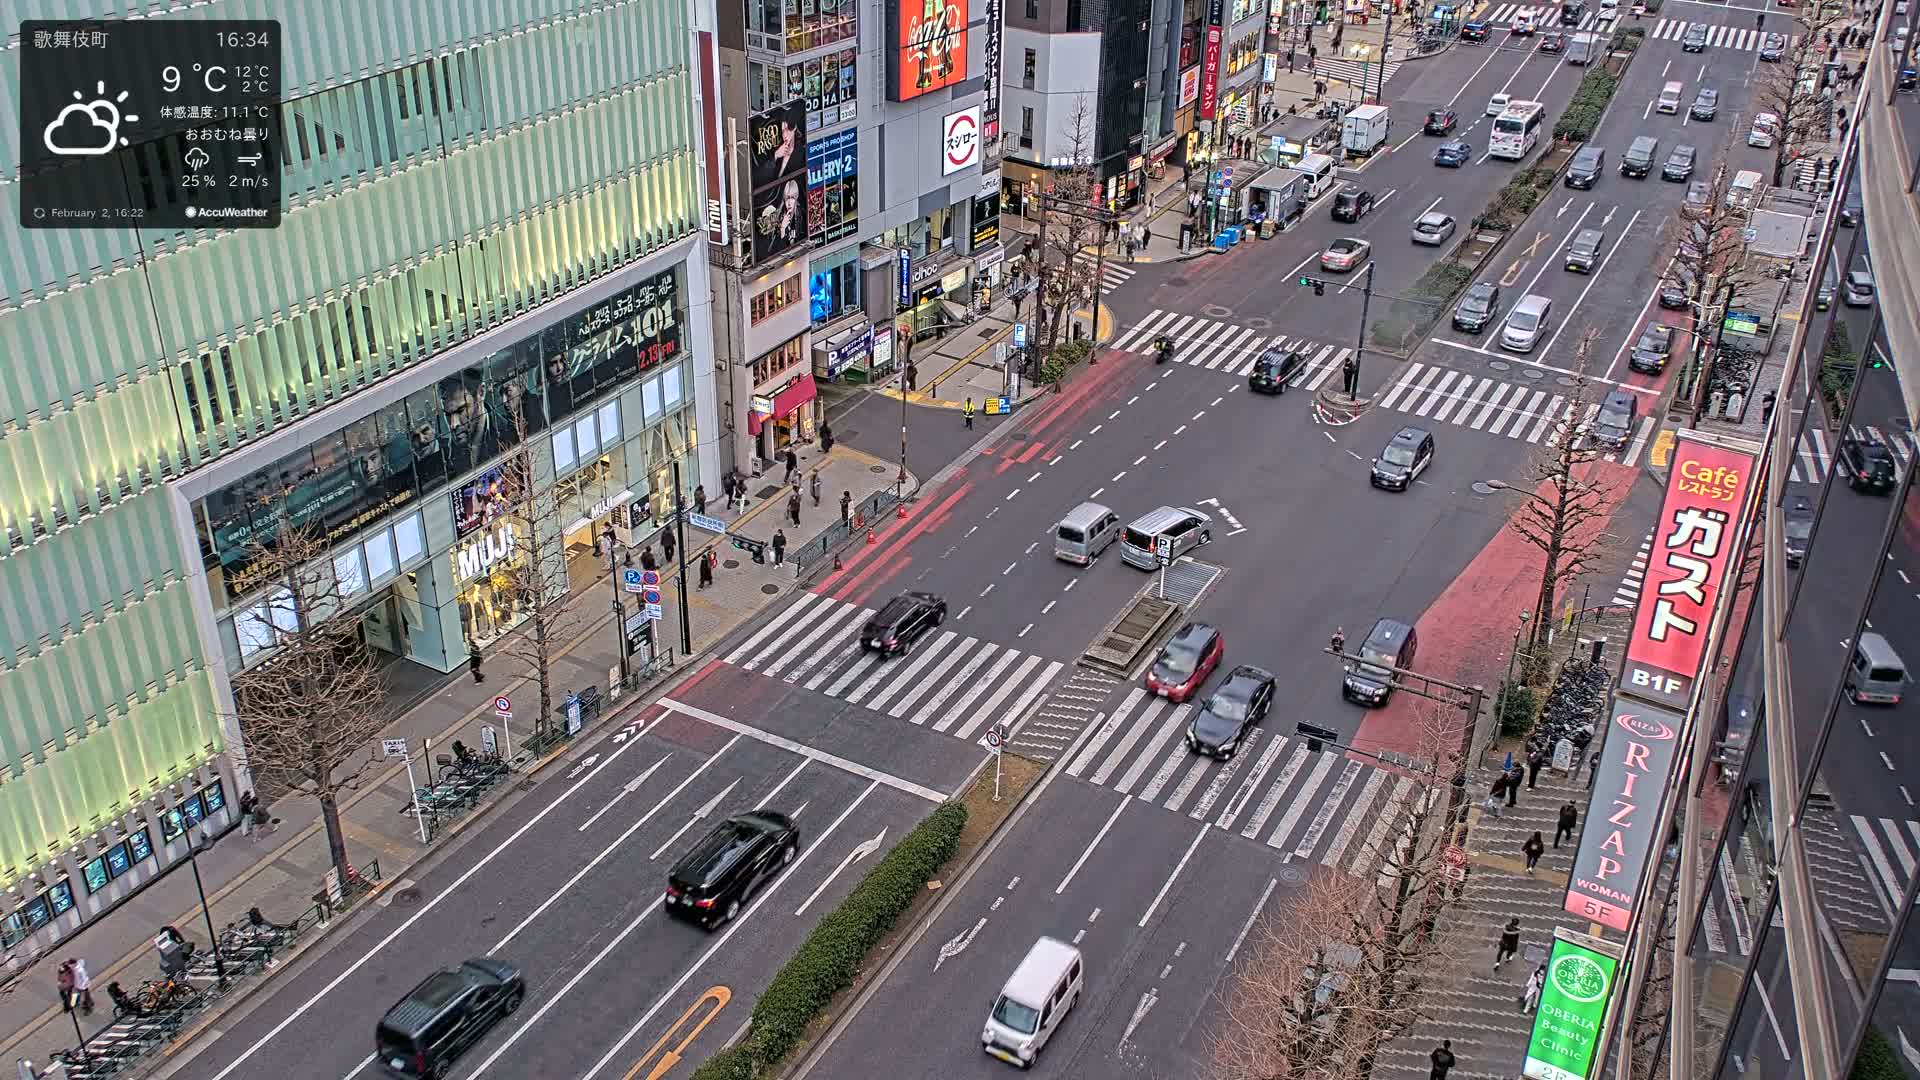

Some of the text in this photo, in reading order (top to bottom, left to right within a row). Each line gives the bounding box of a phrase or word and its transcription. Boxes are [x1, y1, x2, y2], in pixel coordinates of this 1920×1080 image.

[1204, 45, 1218, 110] バーガーキング
[822, 87, 852, 107] HALL
[810, 140, 827, 153] SPORTS
[946, 132, 978, 152] スシロー
[708, 199, 721, 232] MUJI
[1016, 326, 1024, 334] P
[640, 340, 674, 368] 2.13 FRI
[828, 350, 838, 366] P
[999, 398, 1006, 408] P
[1680, 460, 1738, 489] Café
[1678, 480, 1734, 502] レストラン
[590, 496, 614, 519] MUJI
[458, 522, 515, 581] MUJI
[1159, 538, 1168, 548] P
[1648, 506, 1730, 642] ガスト
[1631, 668, 1683, 694] B1F
[1630, 718, 1662, 734] RIZAP
[1594, 740, 1650, 881] RIZAP
[1576, 878, 1632, 904] WOMAN
[1584, 901, 1613, 920] 5F
[1558, 969, 1599, 990] OBERIA
[1542, 1004, 1594, 1031] OBERIA
[1542, 1020, 1589, 1046] Beauty
[1540, 1038, 1583, 1060] Clinic
[1542, 1066, 1567, 1080] 2F
